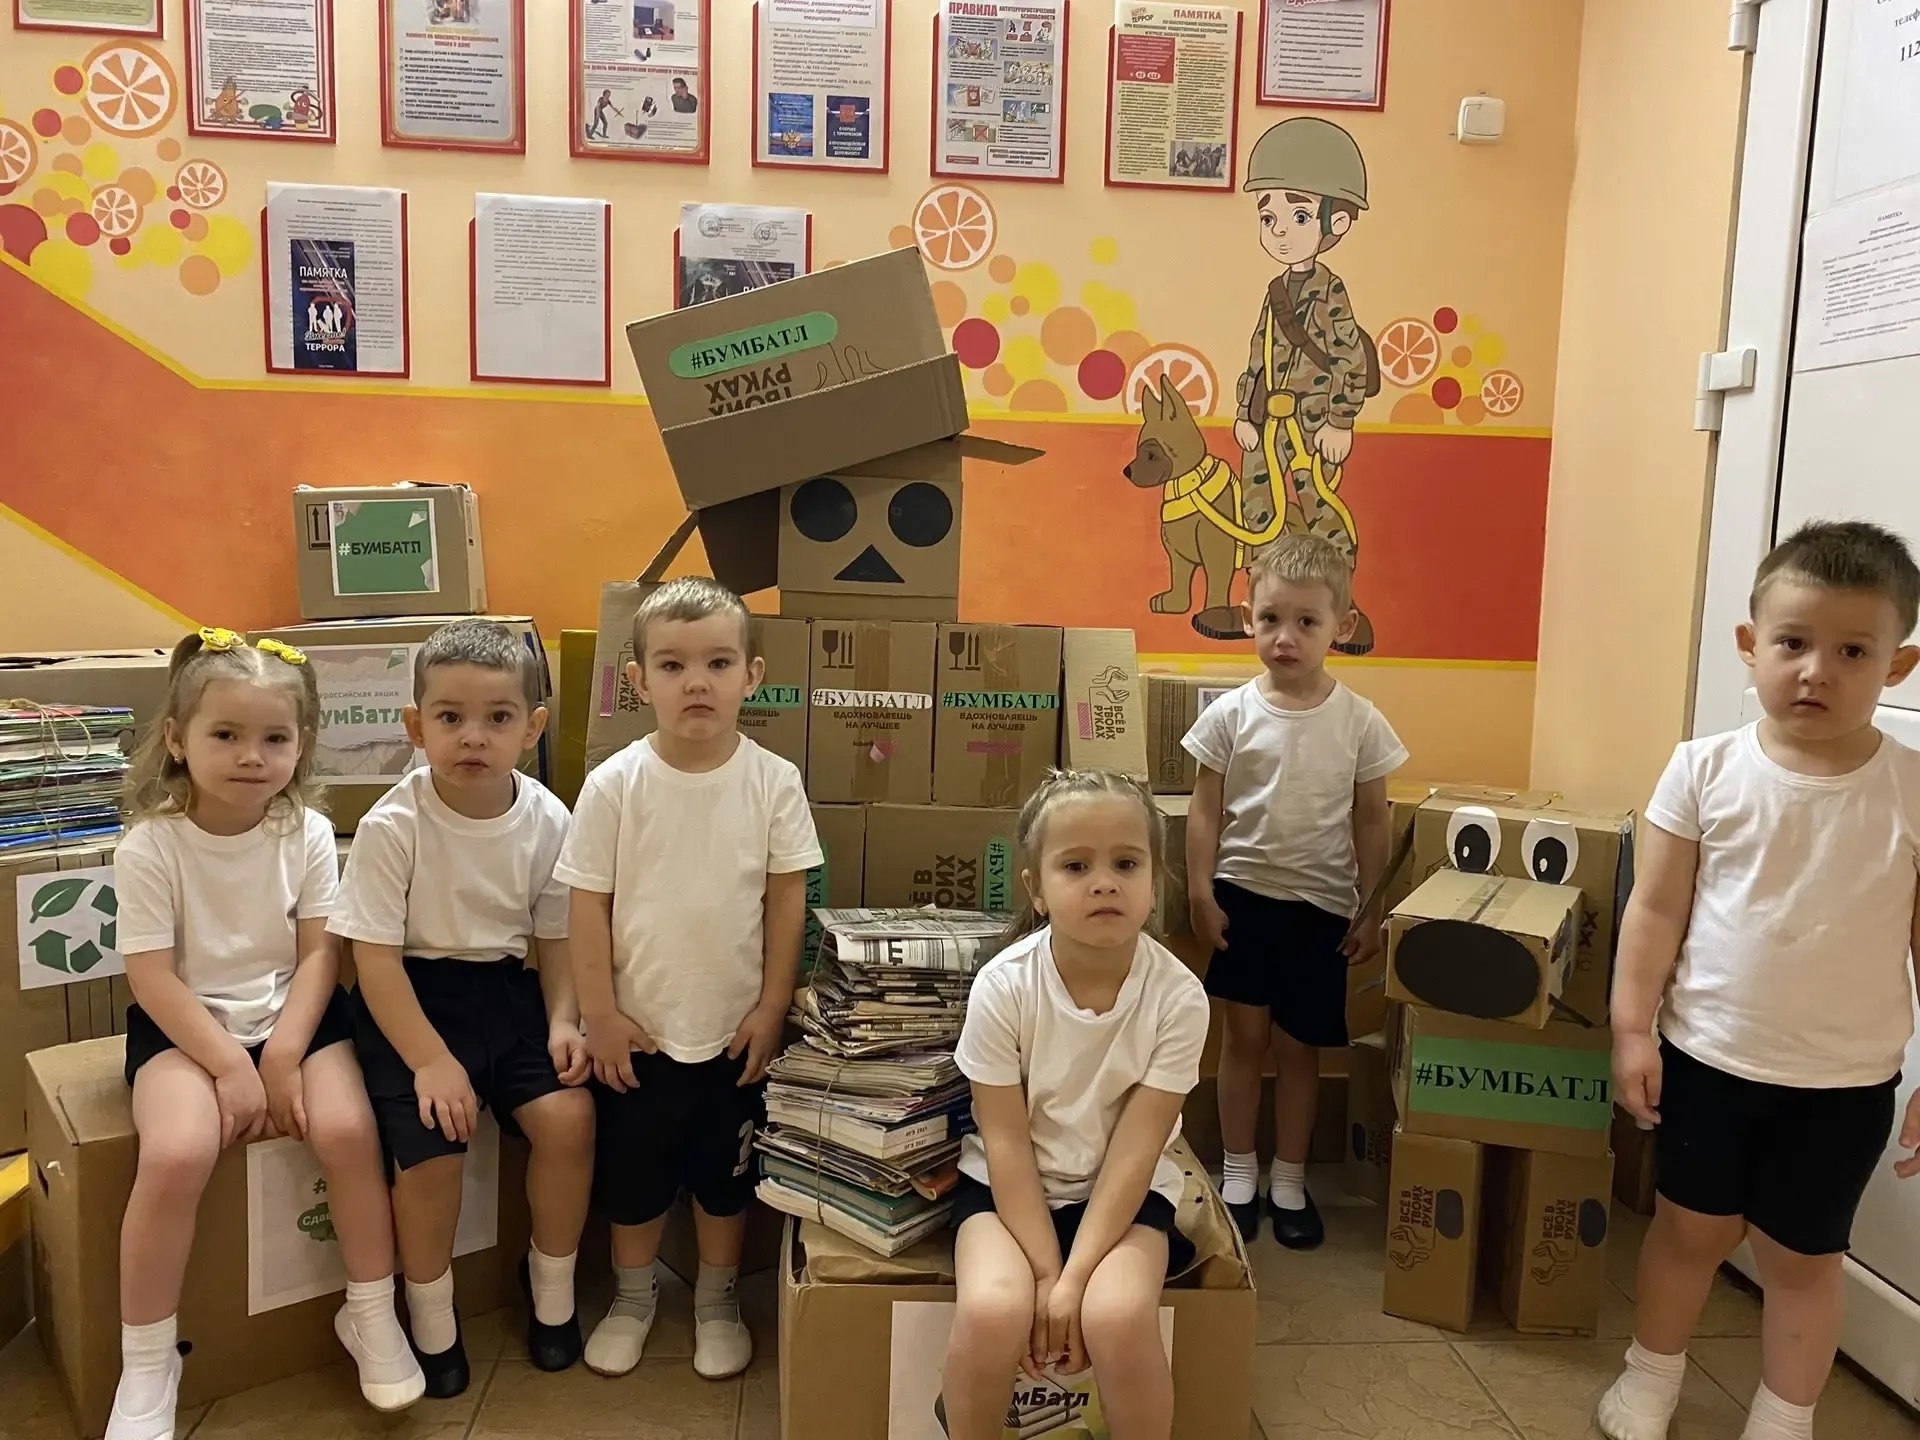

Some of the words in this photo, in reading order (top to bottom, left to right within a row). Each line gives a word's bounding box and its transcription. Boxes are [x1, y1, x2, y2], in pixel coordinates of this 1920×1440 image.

[949, 2, 998, 16] ПРАВИЛА
[1132, 14, 1154, 23] ТЕРРОР
[1173, 9, 1222, 20] ПАМЯТКА
[1900, 40, 1920, 61] 112
[299, 266, 348, 279] ПАМЯТКА
[305, 342, 346, 352] ТЕРРОРА
[690, 324, 809, 370] #БУМБАТЛ
[703, 363, 792, 404] РУКАХ
[812, 690, 927, 709] #БУМБАТЛ
[943, 691, 1056, 709] #БУМБАТЛ
[319, 705, 405, 730] умБатл
[833, 711, 912, 720] ВДОХНОВЛЯЕШЬ
[959, 712, 1038, 721] ВДОХНОВЛЯЕШЬ
[1093, 705, 1105, 739] РУКАХ
[1104, 705, 1116, 741] ТВОИХ
[1114, 705, 1127, 725] ВСЁ
[845, 721, 859, 729] НА
[861, 721, 900, 730] ЛУЧШЕЕ
[971, 722, 985, 730] НА
[986, 723, 1026, 731] ЛУЧШЕЕ
[1416, 1062, 1609, 1104] #БУМБАТЛ
[1410, 1184, 1423, 1225] ТВОИХ
[1421, 1188, 1433, 1228] РУКАХ
[302, 1213, 329, 1226] Сда
[1553, 1198, 1566, 1238] ТВОИХ
[1564, 1200, 1577, 1240] РУКАХ
[1012, 1387, 1090, 1407] мБатл
